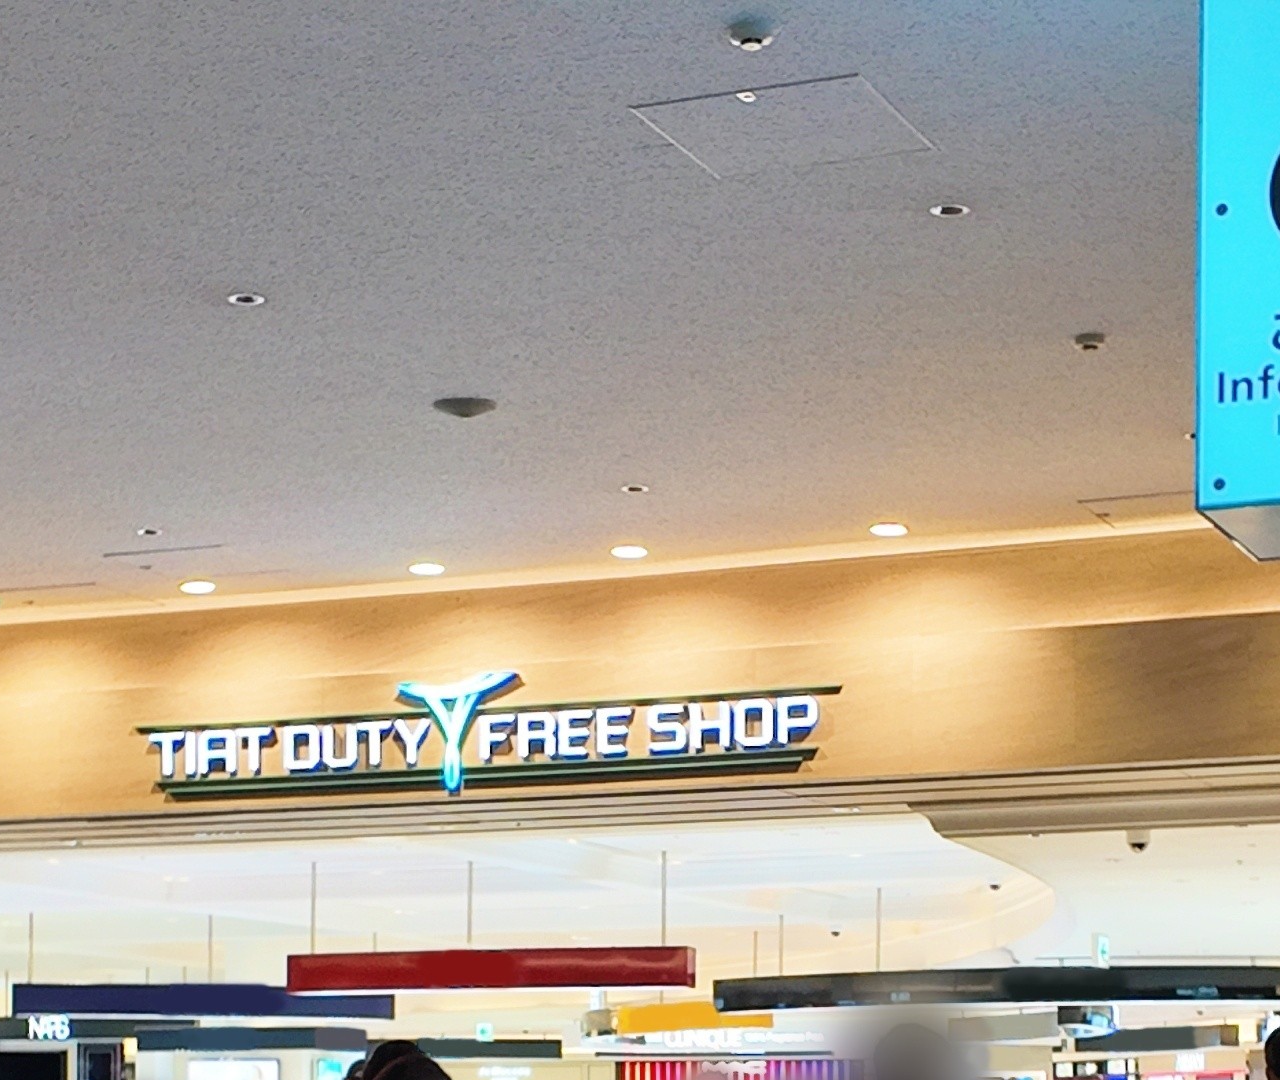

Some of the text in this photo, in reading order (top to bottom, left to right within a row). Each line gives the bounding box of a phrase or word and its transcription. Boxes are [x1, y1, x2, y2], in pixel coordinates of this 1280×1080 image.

[149, 694, 819, 776] TIAT DUTY FREE SHOP
[663, 1030, 743, 1049] CLINIQUE
